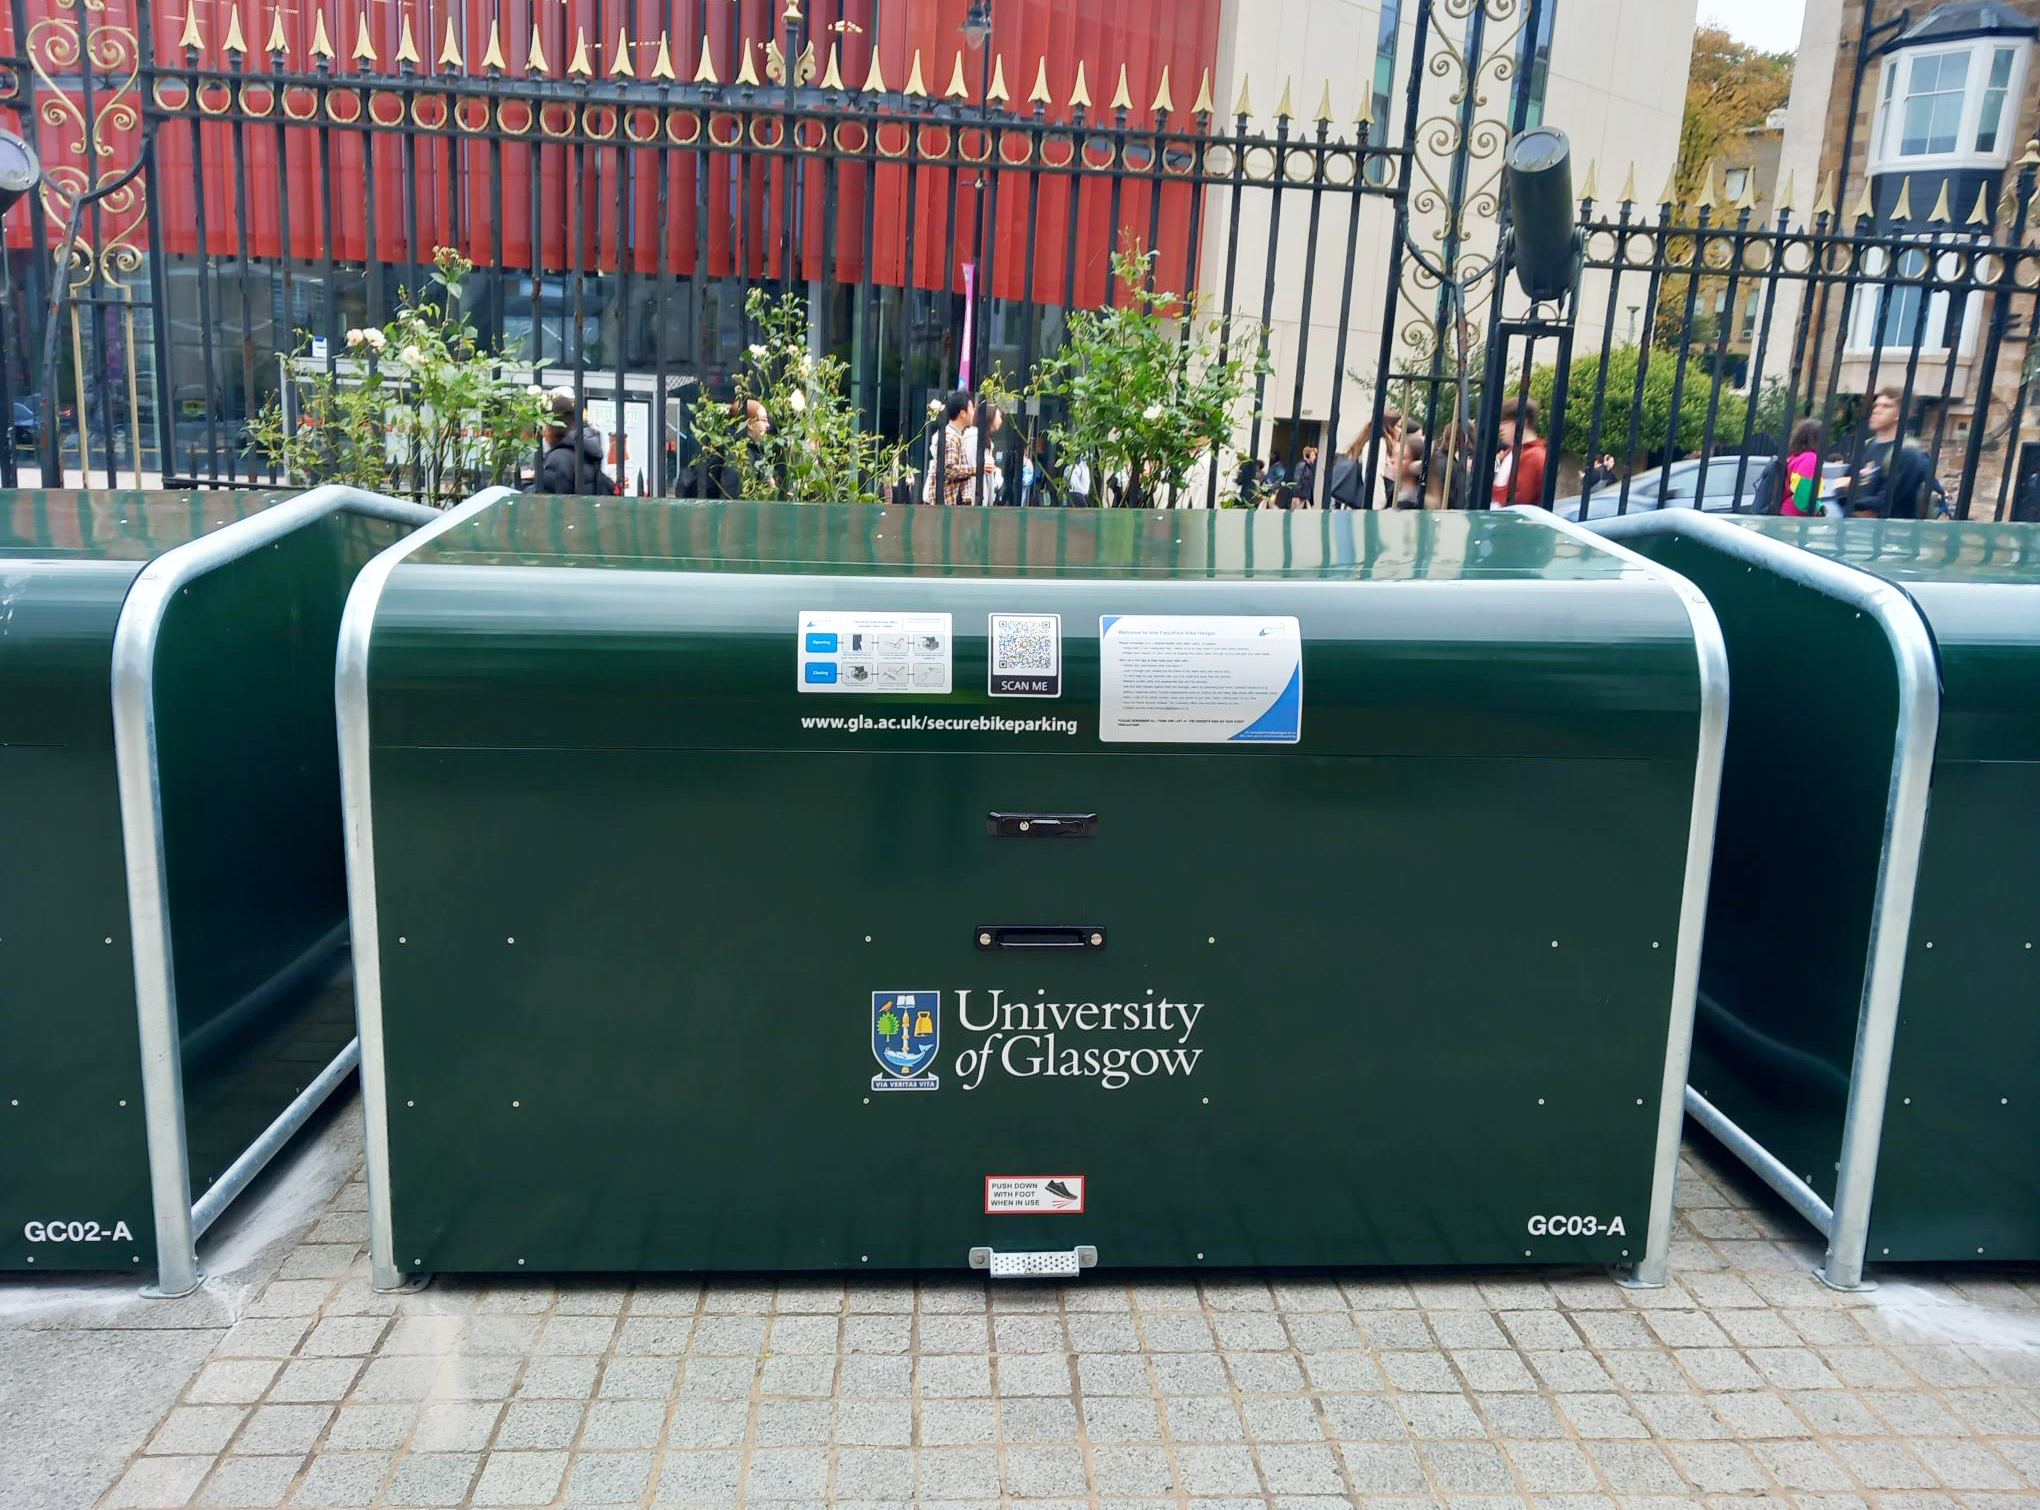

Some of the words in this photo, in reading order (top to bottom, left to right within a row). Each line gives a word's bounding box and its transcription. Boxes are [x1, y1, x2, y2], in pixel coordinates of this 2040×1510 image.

[1001, 681, 1029, 691] SCAN
[1032, 681, 1048, 691] ME
[800, 714, 1078, 734] www.gla.ac.uk/securebikeparking
[954, 988, 1205, 1044] University
[955, 1032, 1003, 1090] of
[1001, 1031, 1204, 1089] Glasgow
[24, 1220, 134, 1242] GC02-A
[1527, 1215, 1626, 1236] GC03-A
